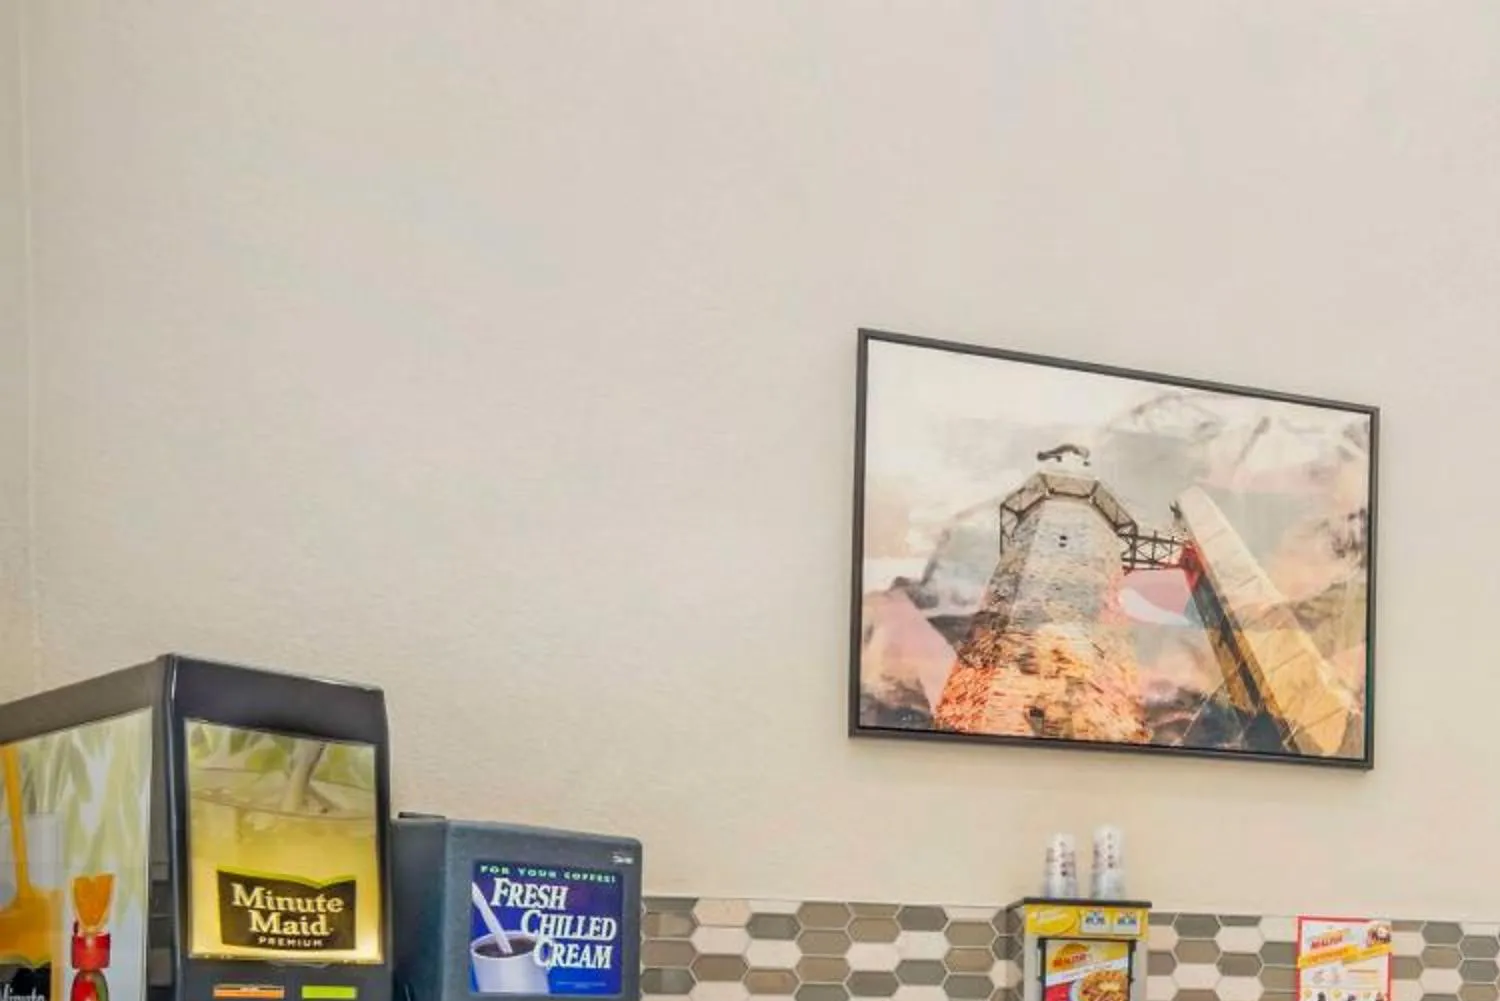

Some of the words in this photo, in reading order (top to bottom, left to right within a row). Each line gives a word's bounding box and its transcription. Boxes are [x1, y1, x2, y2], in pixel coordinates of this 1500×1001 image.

[480, 865, 510, 875] FOR
[517, 867, 557, 878] YOUR
[230, 882, 345, 913] Minute
[490, 877, 569, 910] FRESH
[248, 909, 331, 937] Maid
[520, 909, 617, 941] CHILLED
[257, 936, 324, 947] PREMIUM
[533, 938, 613, 970] CREAM
